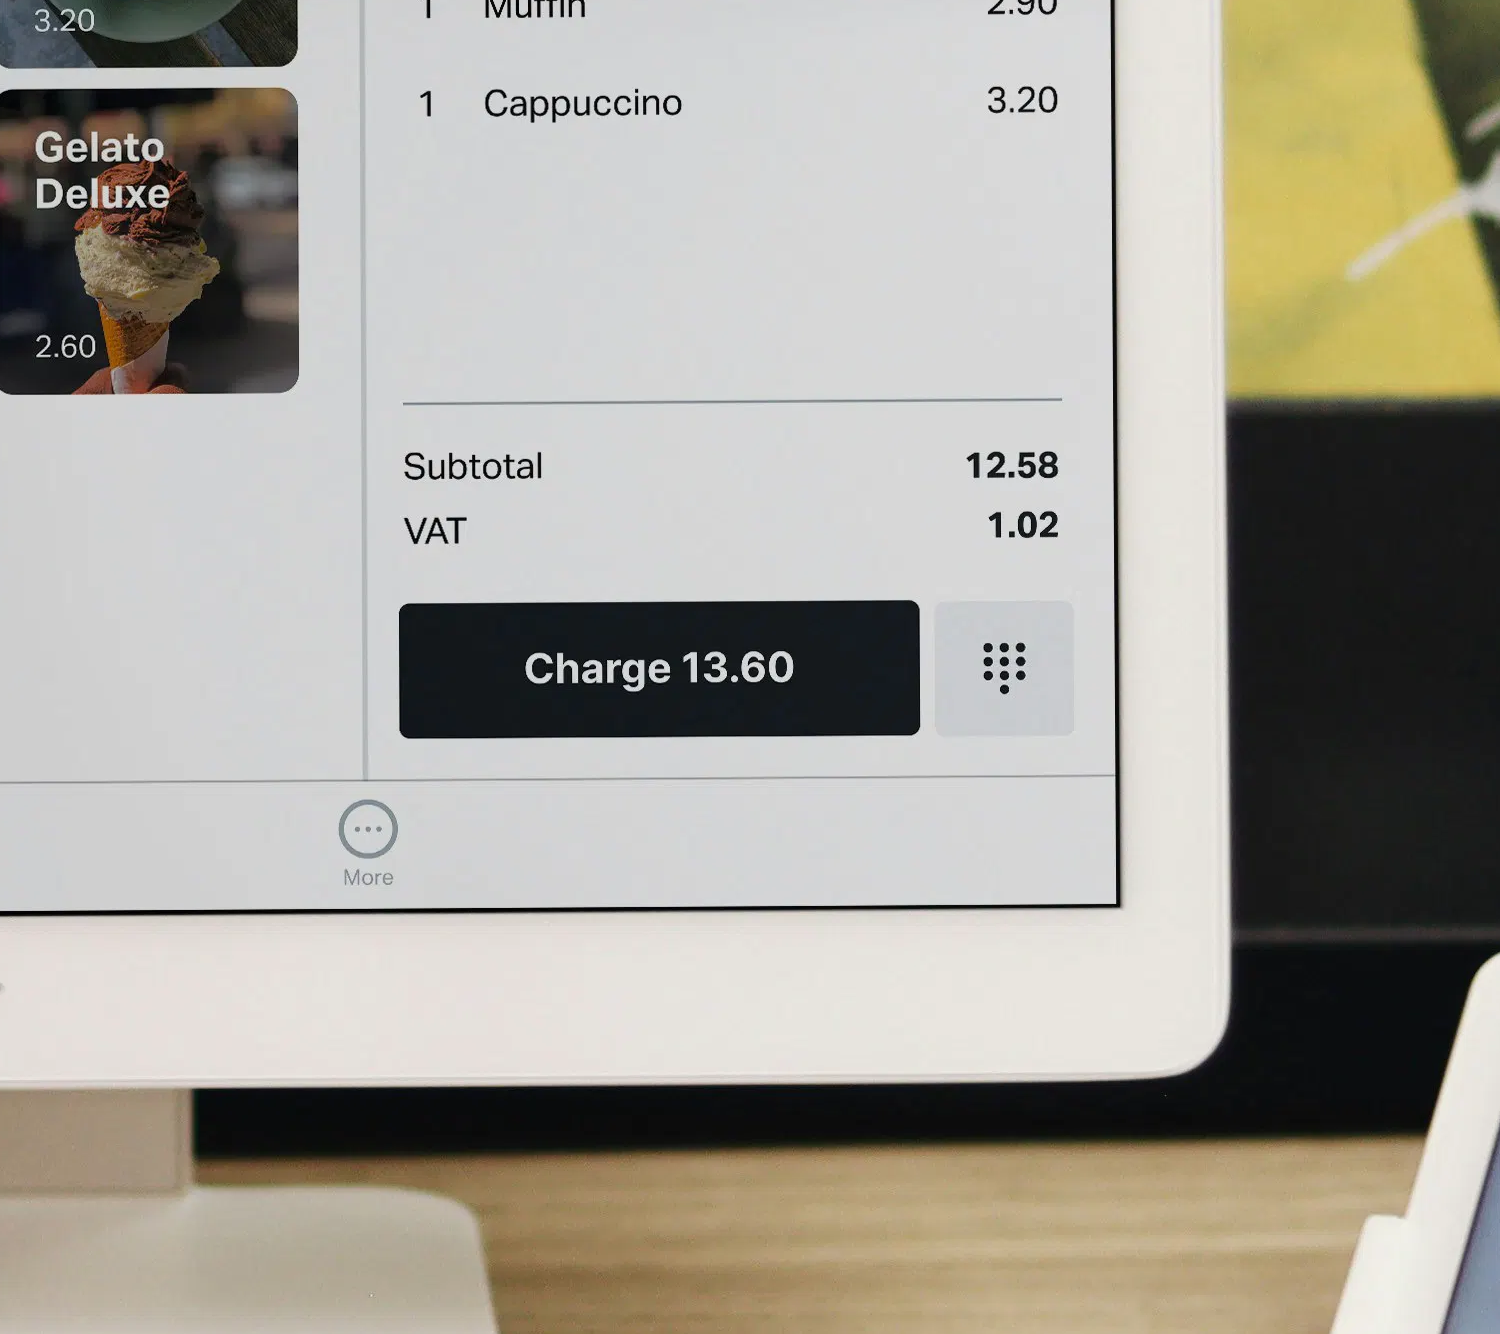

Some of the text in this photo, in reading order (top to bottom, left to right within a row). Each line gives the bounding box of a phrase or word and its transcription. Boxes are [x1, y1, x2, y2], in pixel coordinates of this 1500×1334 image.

[34, 7, 95, 33] 3.20
[418, 86, 1059, 123] 1 Cappuccino 3.20
[35, 130, 165, 163] Gelato
[35, 177, 170, 210] Deluxe
[34, 333, 96, 360] 2.60
[403, 450, 1059, 481] Subtotal 12.58
[404, 510, 1059, 545] VAT 1.02
[524, 649, 794, 692] Charge 13.60
[342, 867, 395, 888] More
